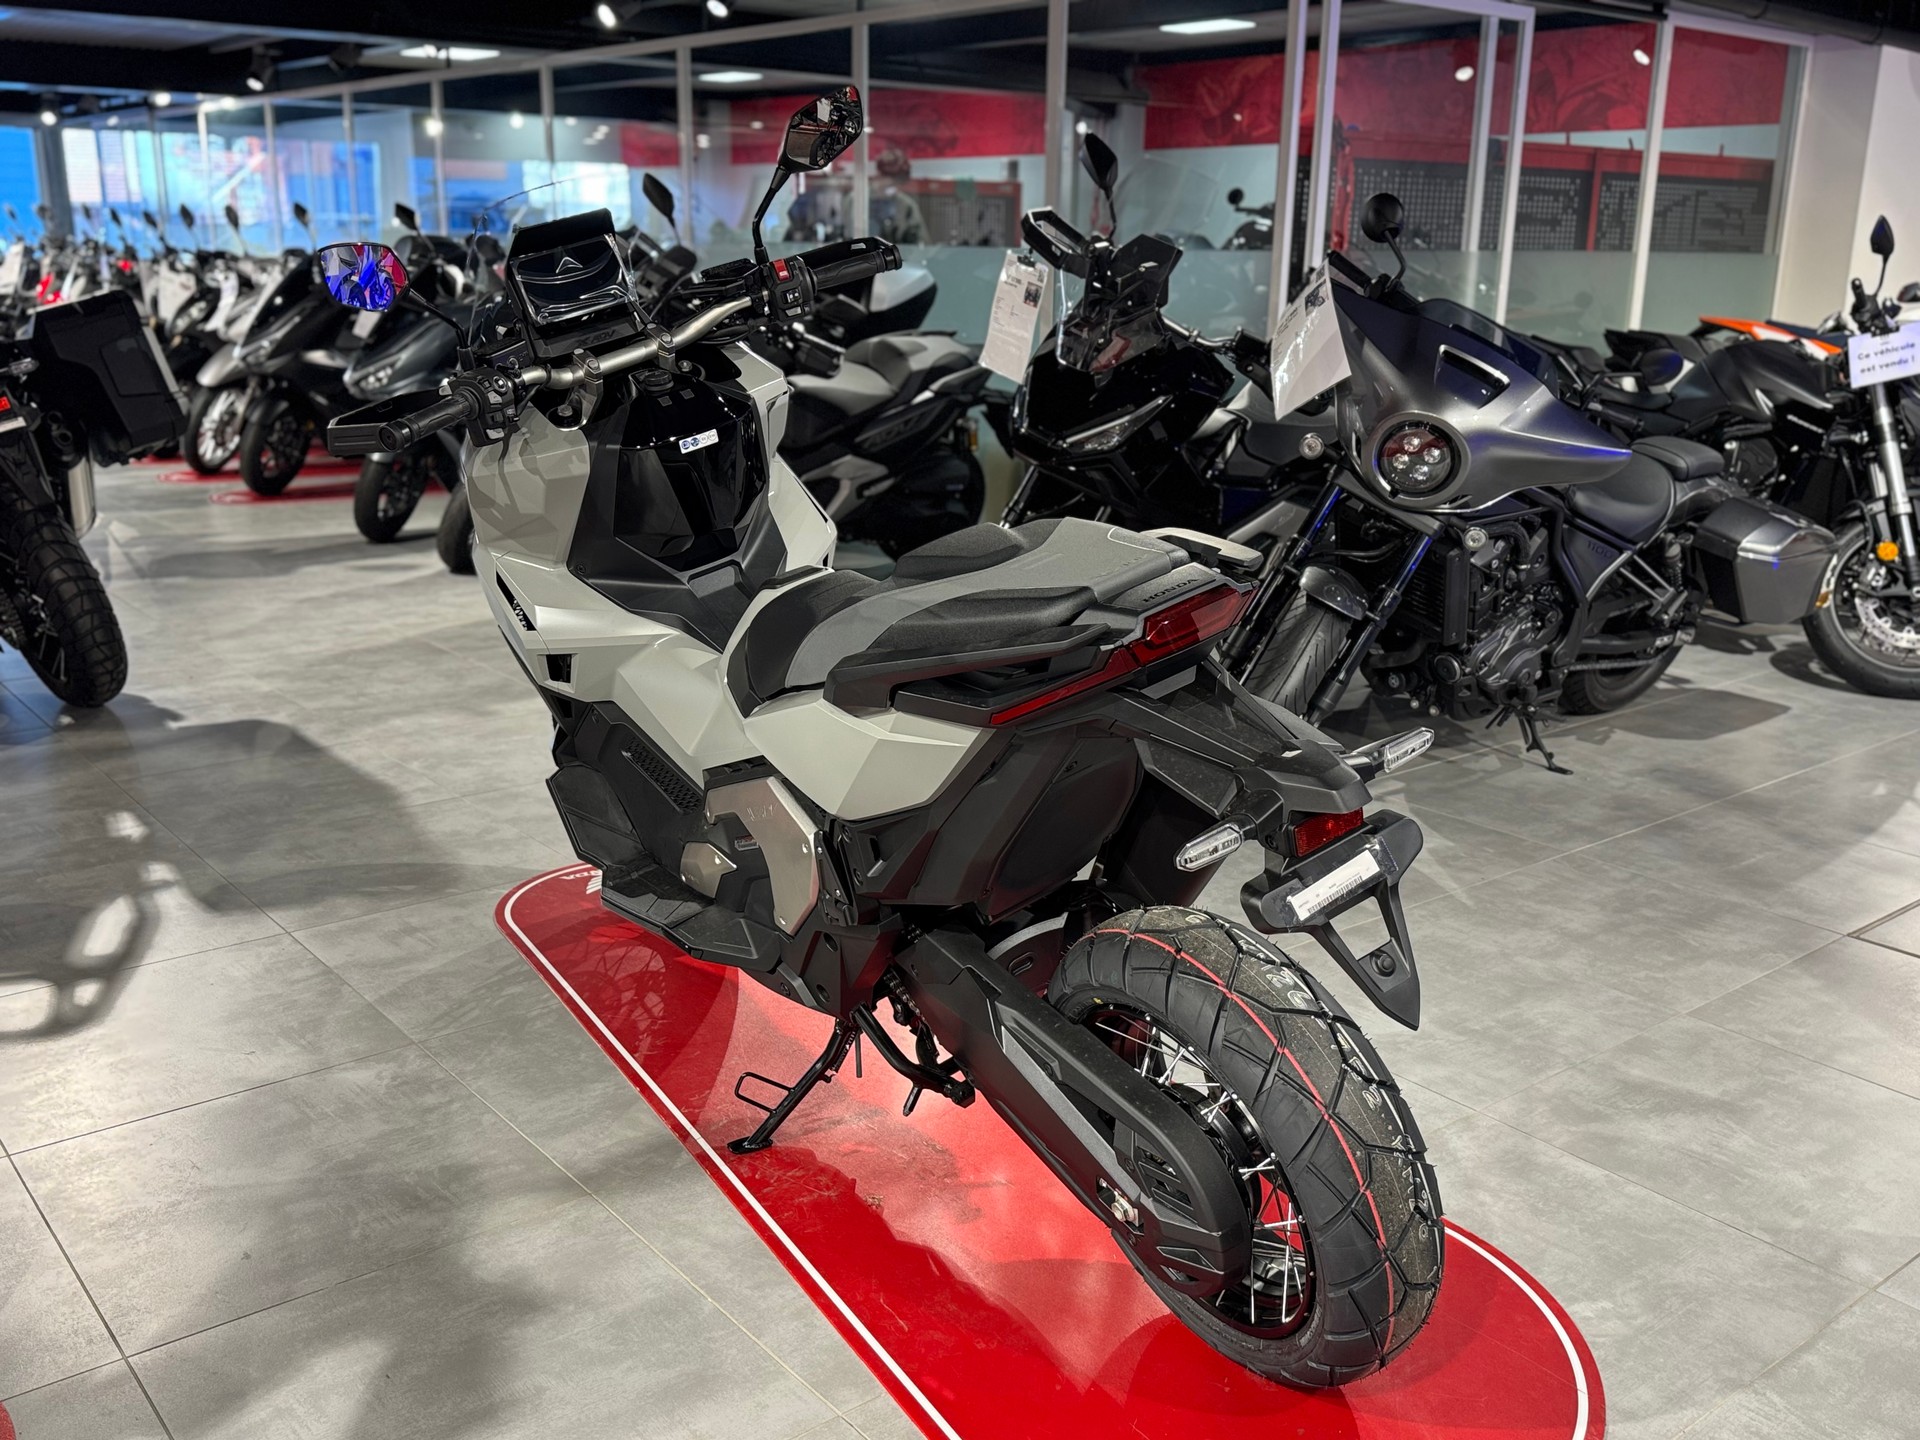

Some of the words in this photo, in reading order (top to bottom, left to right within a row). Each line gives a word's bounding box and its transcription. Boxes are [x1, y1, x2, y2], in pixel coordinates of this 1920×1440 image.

[1857, 352, 1870, 360] Ce
[1860, 364, 1875, 373] est
[1879, 359, 1909, 369] vendu
[1142, 578, 1200, 603] HONDA
